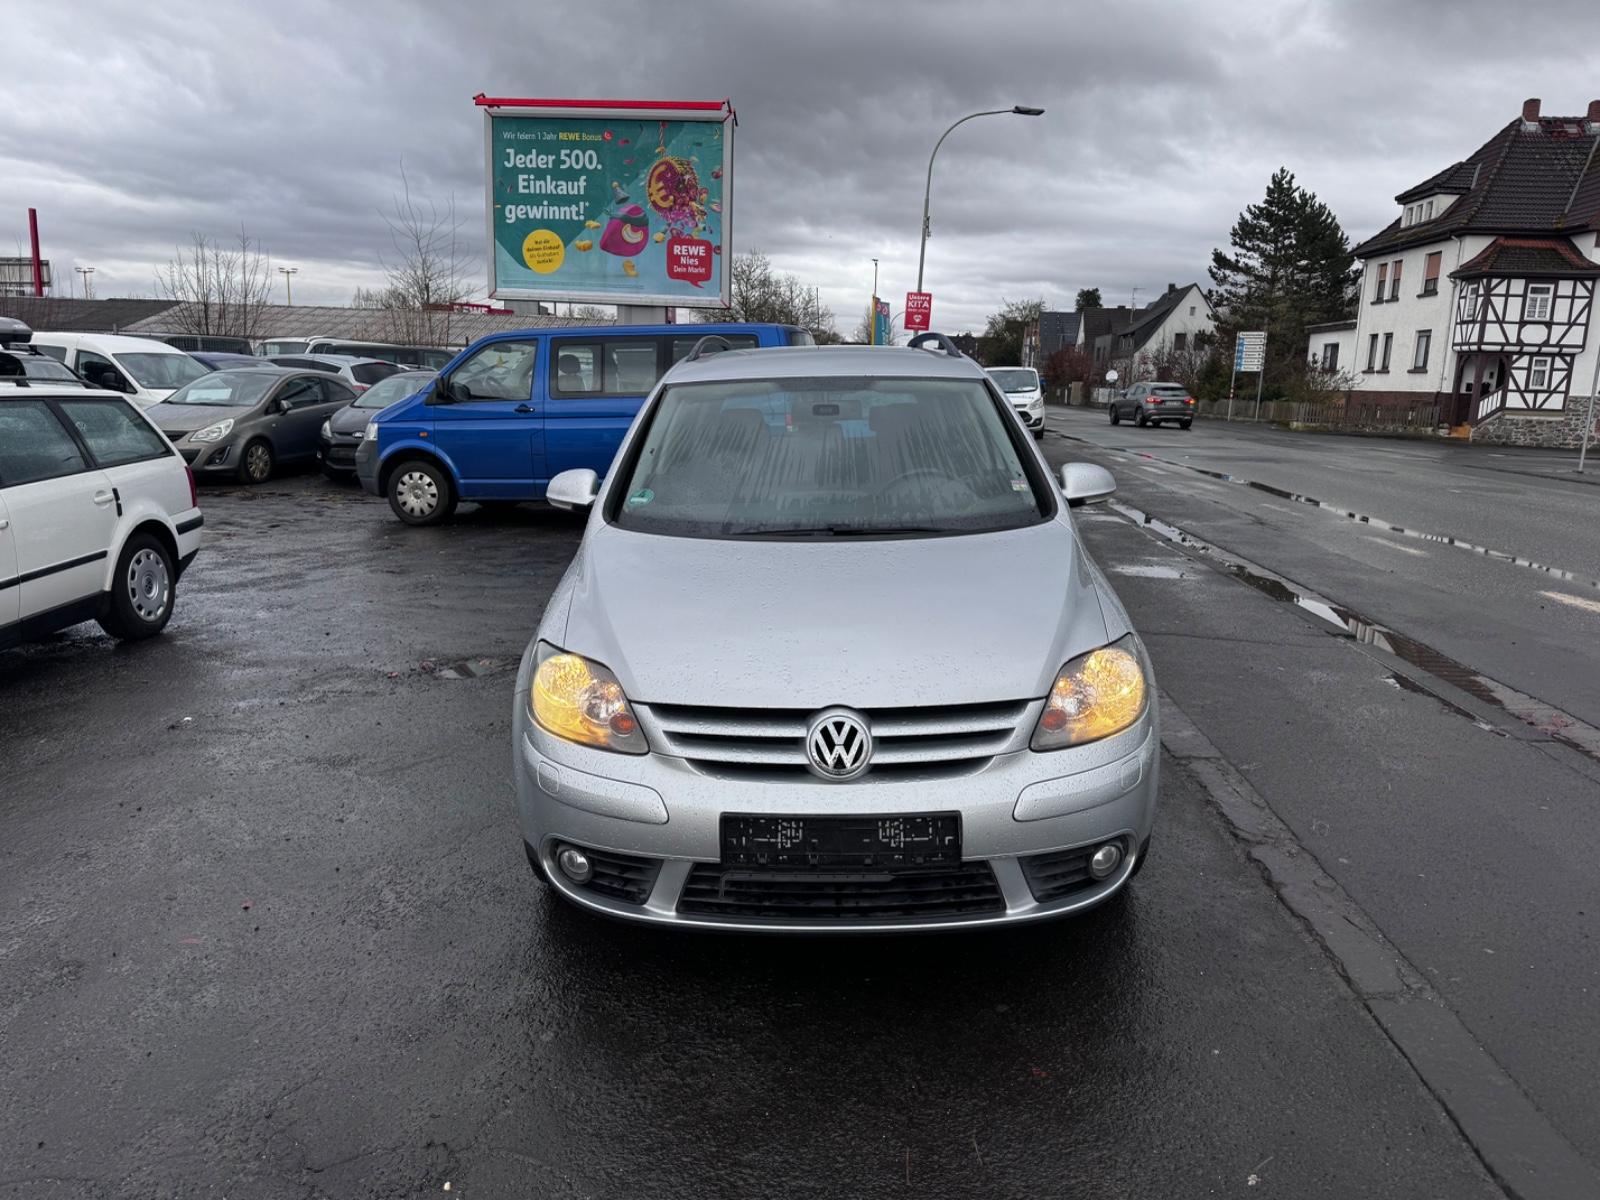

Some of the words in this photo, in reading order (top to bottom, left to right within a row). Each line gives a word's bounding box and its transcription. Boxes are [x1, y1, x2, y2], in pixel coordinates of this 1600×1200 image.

[503, 131, 515, 139] Wir
[517, 131, 535, 139] feiern
[542, 132, 557, 140] Jahr
[559, 132, 580, 140] REWE
[582, 133, 602, 141] Bonus
[504, 149, 555, 168] Jeder
[560, 149, 602, 170] 500.
[518, 175, 586, 194] Einkauf
[674, 245, 705, 256] REWE
[681, 256, 698, 265] Nies
